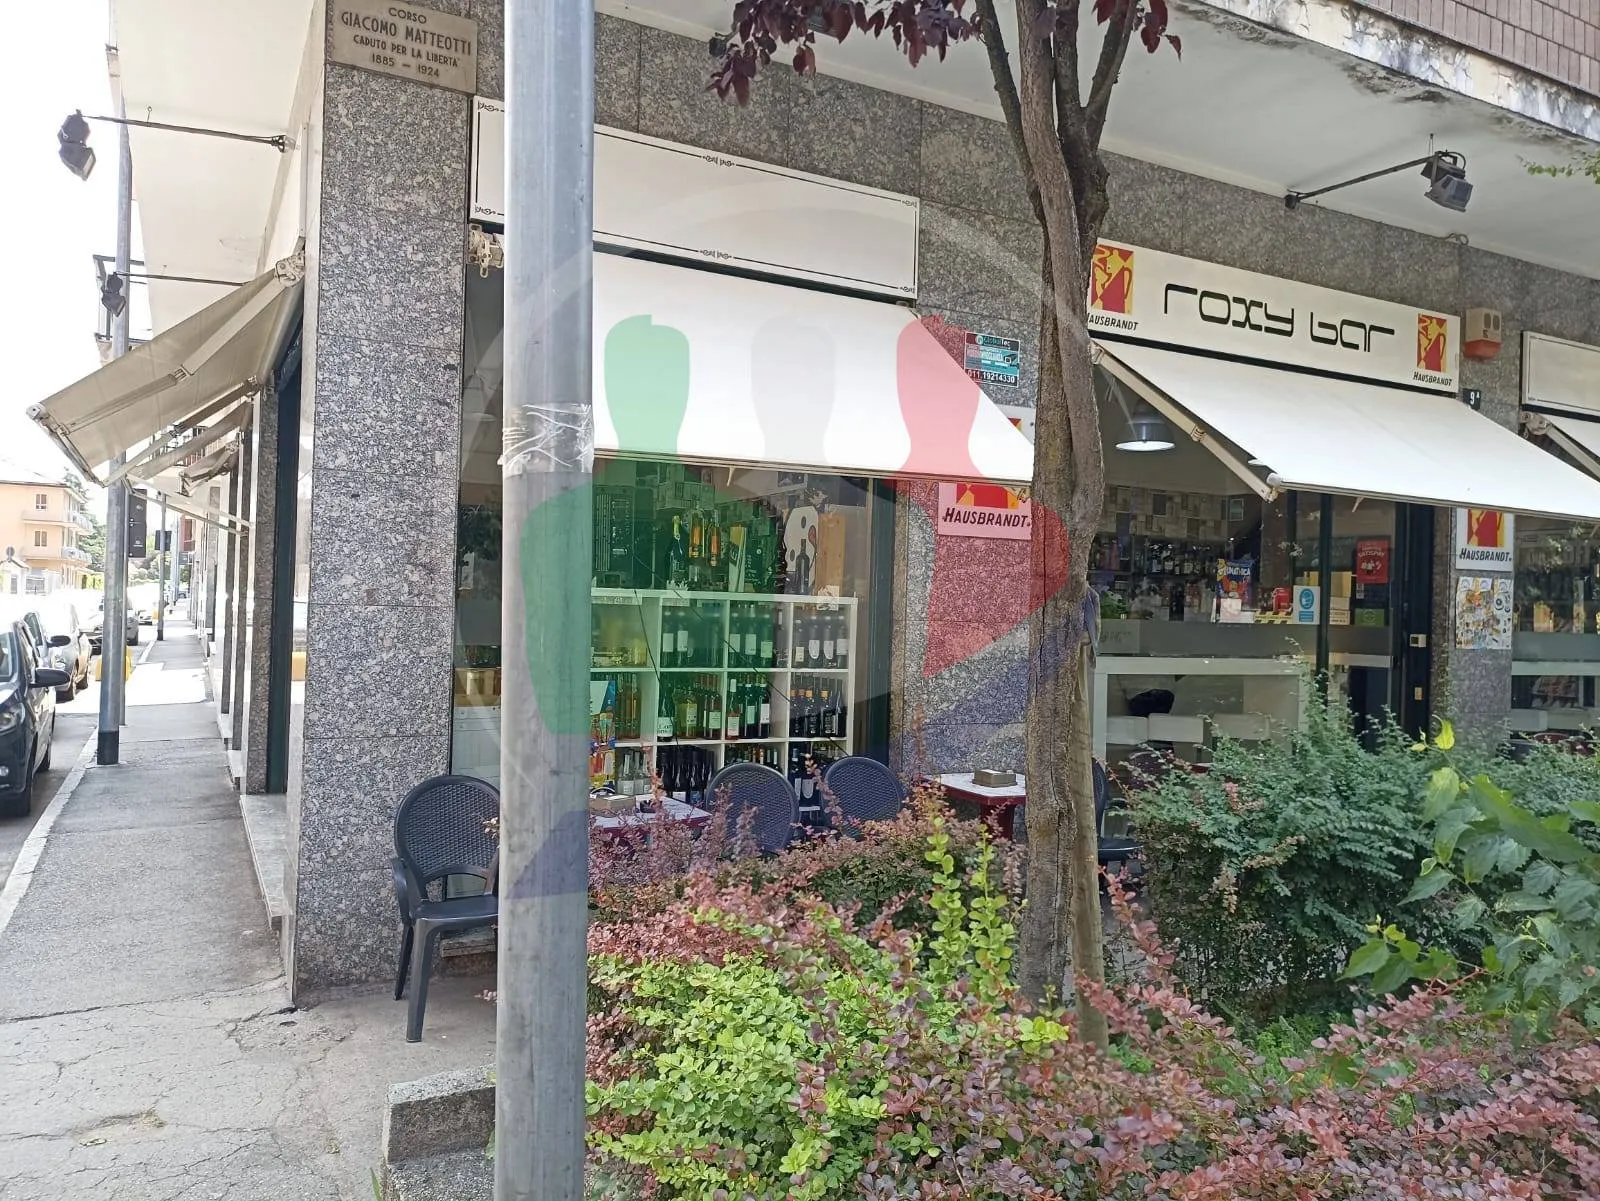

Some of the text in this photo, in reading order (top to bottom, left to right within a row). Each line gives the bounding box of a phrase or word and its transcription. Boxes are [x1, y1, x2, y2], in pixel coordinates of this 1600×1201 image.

[389, 7, 427, 24] CORSO
[341, 12, 471, 56] GIACOMO MATTEOTTI
[353, 34, 387, 50] CADUTO
[391, 43, 407, 56] PER
[411, 47, 421, 59] LA
[372, 53, 395, 67] 1885
[418, 65, 440, 77] 1924
[1164, 282, 1395, 353] roxy bar
[1413, 371, 1453, 387] HAUSBRANDT
[943, 507, 1029, 528] HAUSBRANDT
[1460, 547, 1511, 562] HAUSBRANDT
